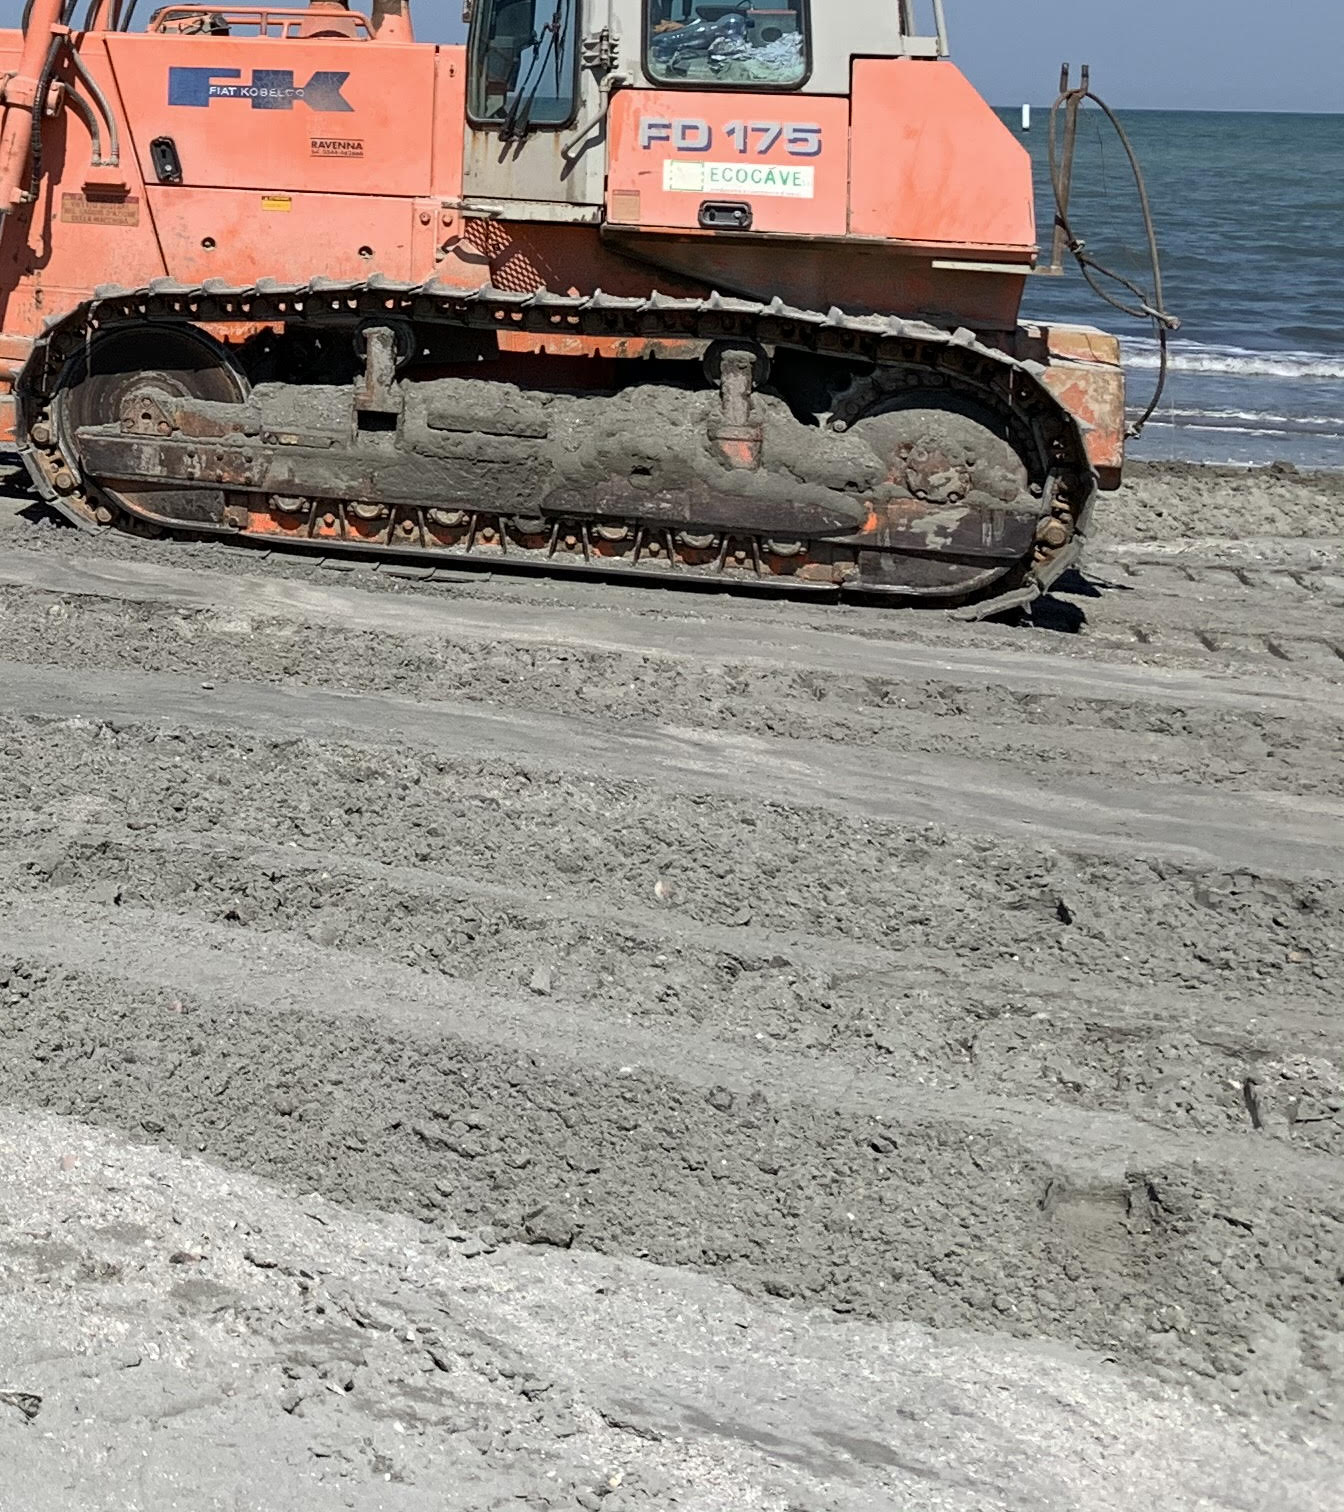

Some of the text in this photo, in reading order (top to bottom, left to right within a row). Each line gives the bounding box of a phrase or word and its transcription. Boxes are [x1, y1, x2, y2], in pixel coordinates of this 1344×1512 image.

[209, 86, 306, 98] FIAT KOBELCO
[639, 116, 822, 157] FD 175
[311, 140, 364, 150] RAVENNA
